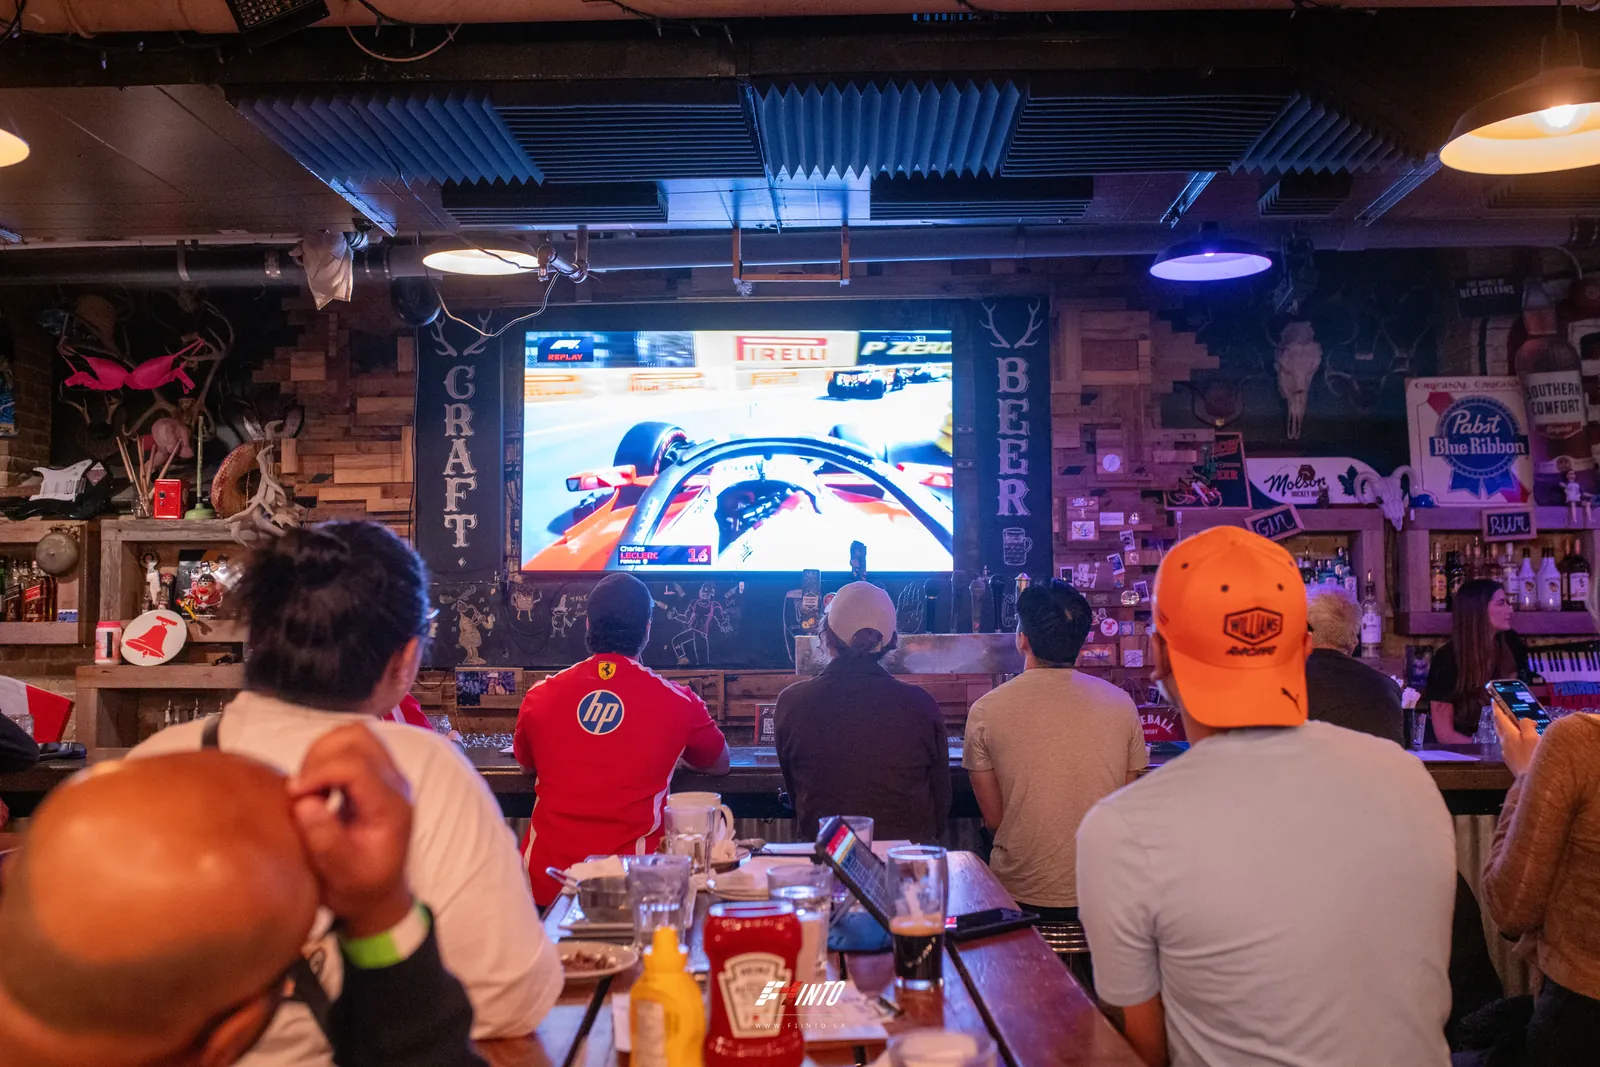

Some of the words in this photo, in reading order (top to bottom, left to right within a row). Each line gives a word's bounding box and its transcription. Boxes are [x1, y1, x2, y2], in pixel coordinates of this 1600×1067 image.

[547, 353, 583, 361] REPLAY
[736, 336, 827, 361] PIRELLI
[861, 341, 887, 356] P
[1525, 382, 1581, 400] SOUTHERN
[1531, 400, 1580, 416] COMFORT
[1450, 409, 1502, 435] Pabst
[996, 357, 1031, 516] BEER
[1433, 437, 1469, 456] Blue
[1470, 435, 1527, 455] Ribbon
[443, 365, 478, 548] CRAFT
[1264, 473, 1327, 498] Molson
[620, 552, 659, 560] LECLERC
[687, 548, 708, 563] 16
[1231, 612, 1279, 639] WILLIAMS
[583, 690, 620, 734] hp
[1140, 713, 1175, 734] EBALL
